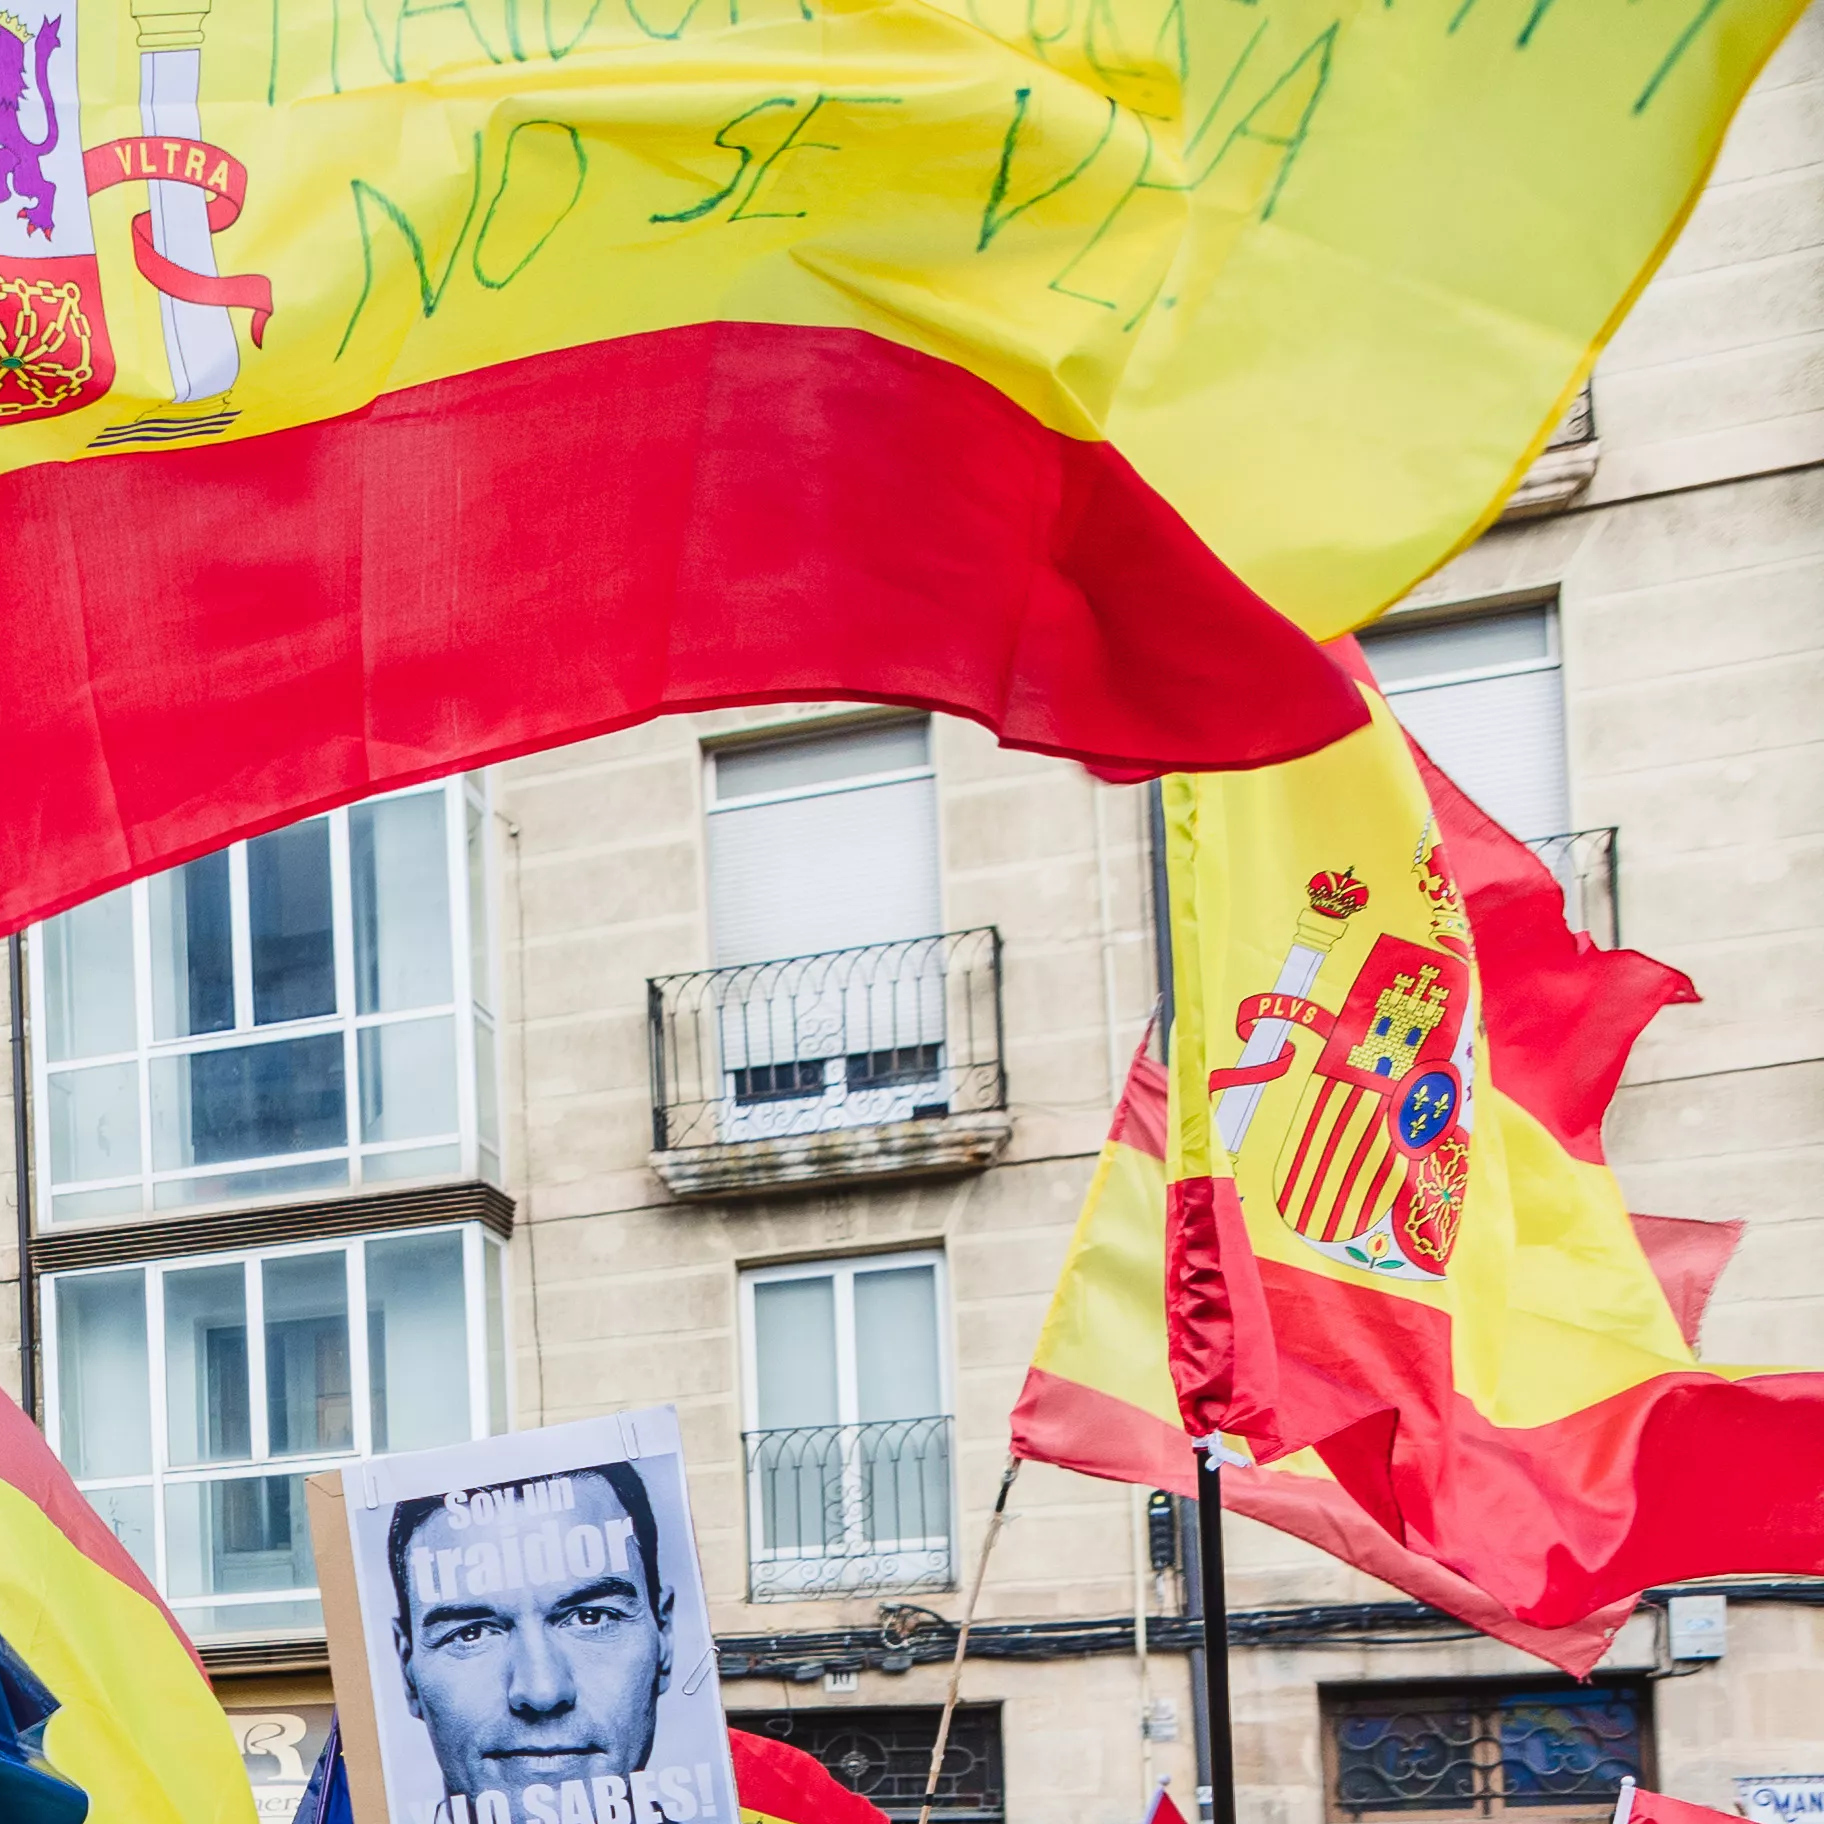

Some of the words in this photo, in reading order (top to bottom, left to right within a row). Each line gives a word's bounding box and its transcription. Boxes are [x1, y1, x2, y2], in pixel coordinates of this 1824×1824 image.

[114, 145, 230, 193] VLTRA
[335, 118, 588, 363] NO
[649, 93, 903, 224] SE
[1258, 996, 1318, 1024] PLVS
[443, 1487, 518, 1531] Soy
[521, 1477, 576, 1518] un
[412, 1515, 635, 1605] traidor
